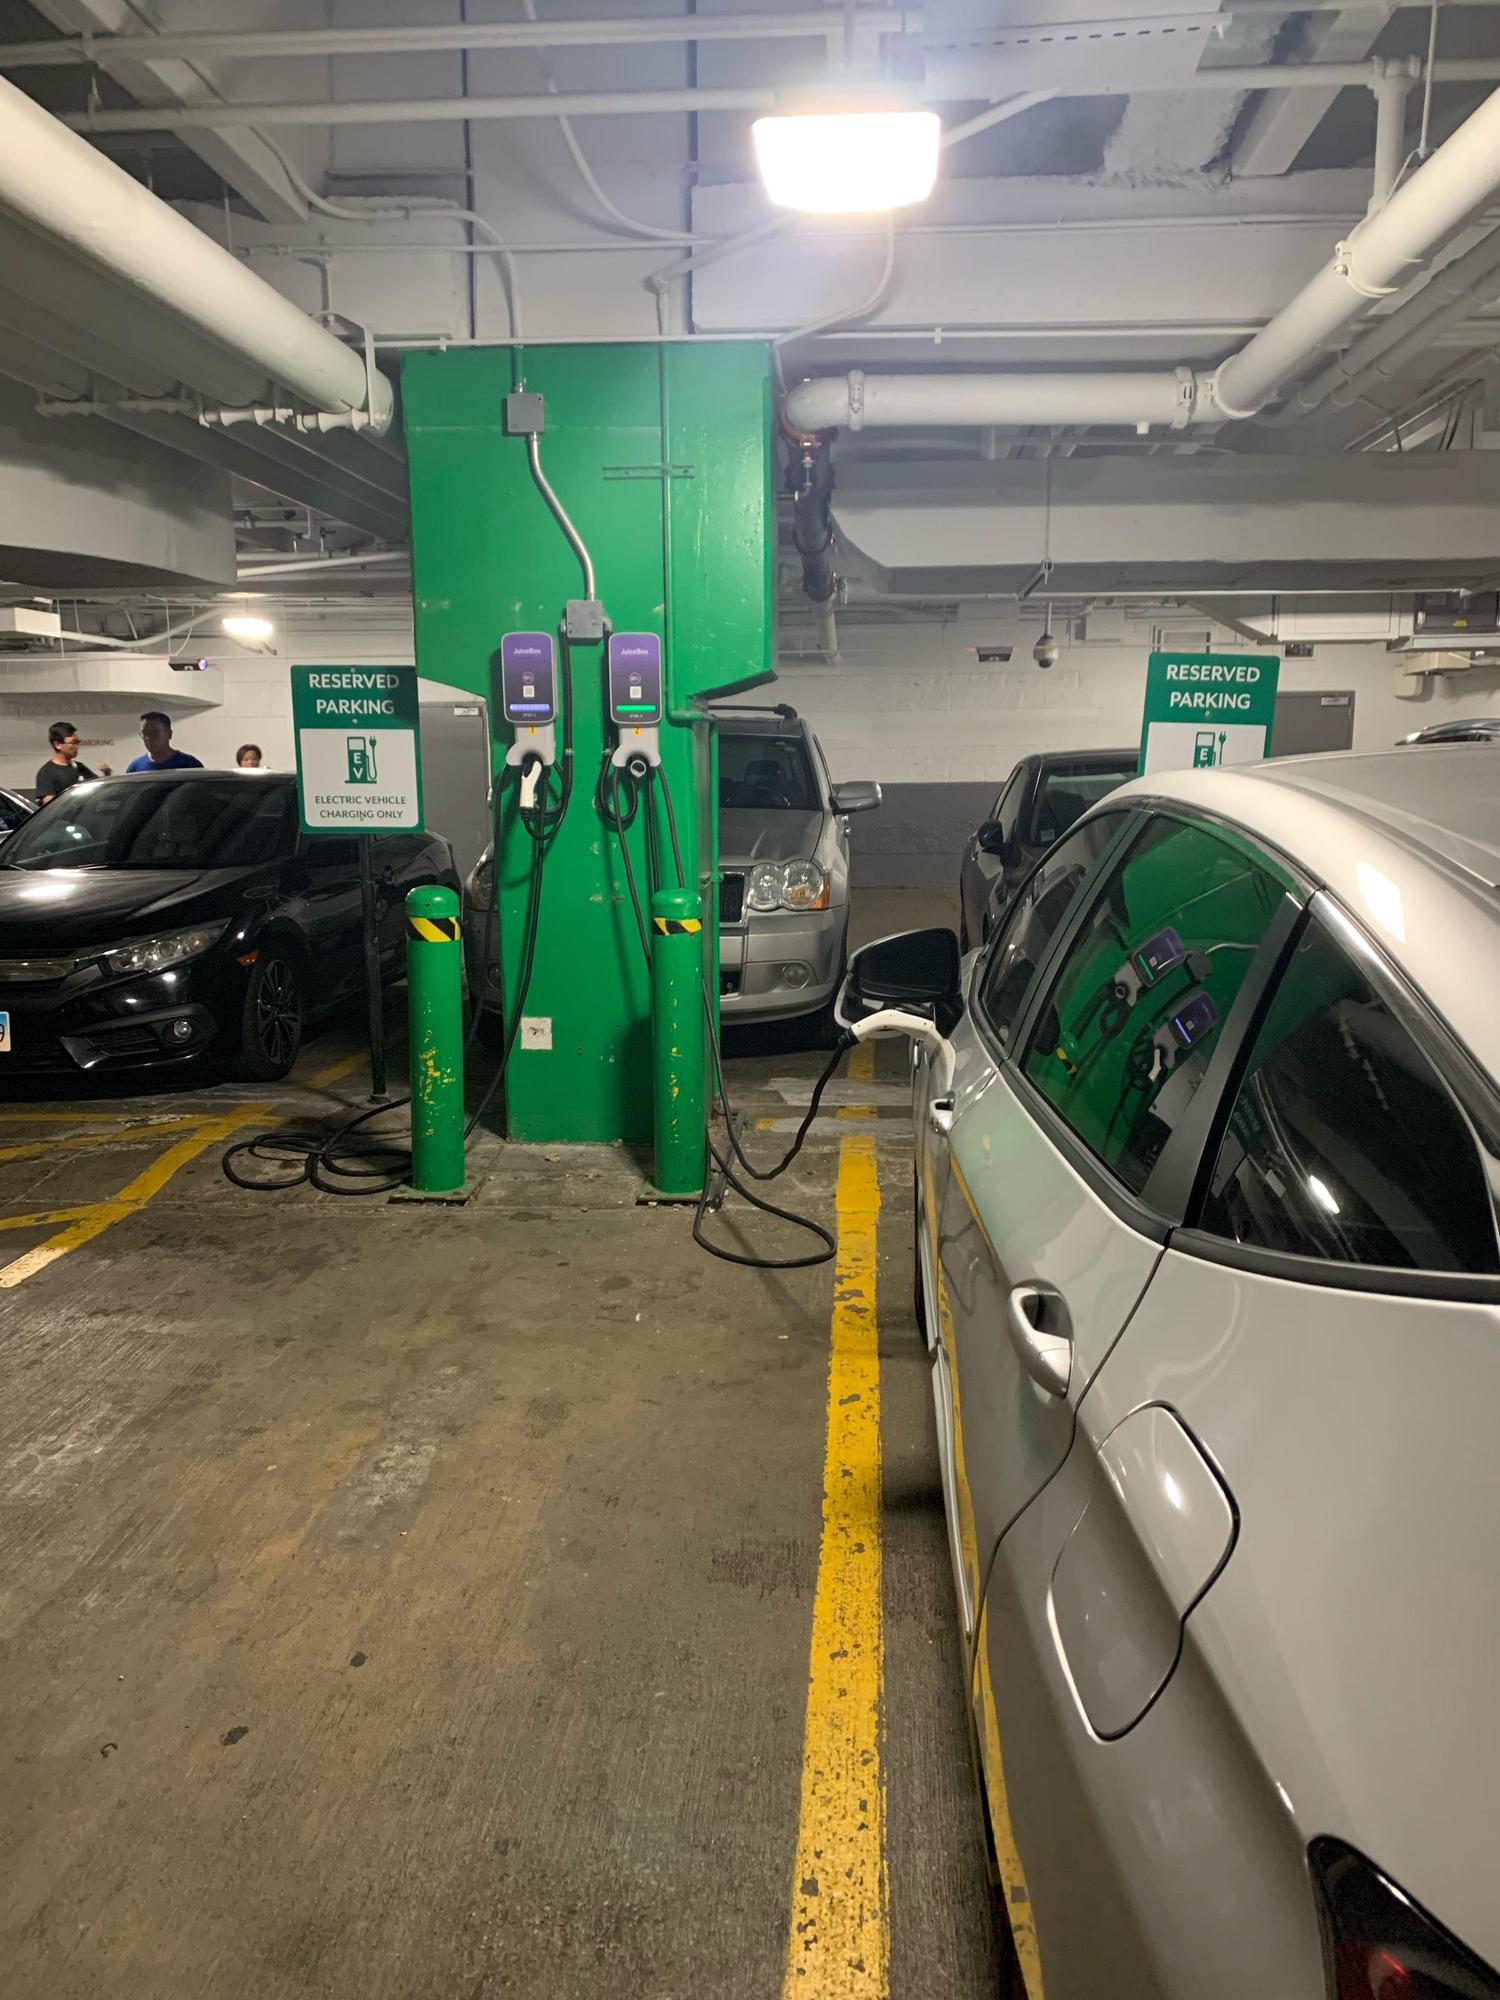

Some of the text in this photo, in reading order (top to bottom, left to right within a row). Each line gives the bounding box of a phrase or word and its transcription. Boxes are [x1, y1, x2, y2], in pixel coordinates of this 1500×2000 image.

[309, 673, 399, 688] RESERVED
[1166, 664, 1260, 682] RESERVED
[316, 699, 394, 714] PARKING
[1169, 691, 1251, 709] PARKING
[315, 796, 406, 804] ELECTRIC VEHICLE
[320, 810, 403, 819] CHARGING ONLY
